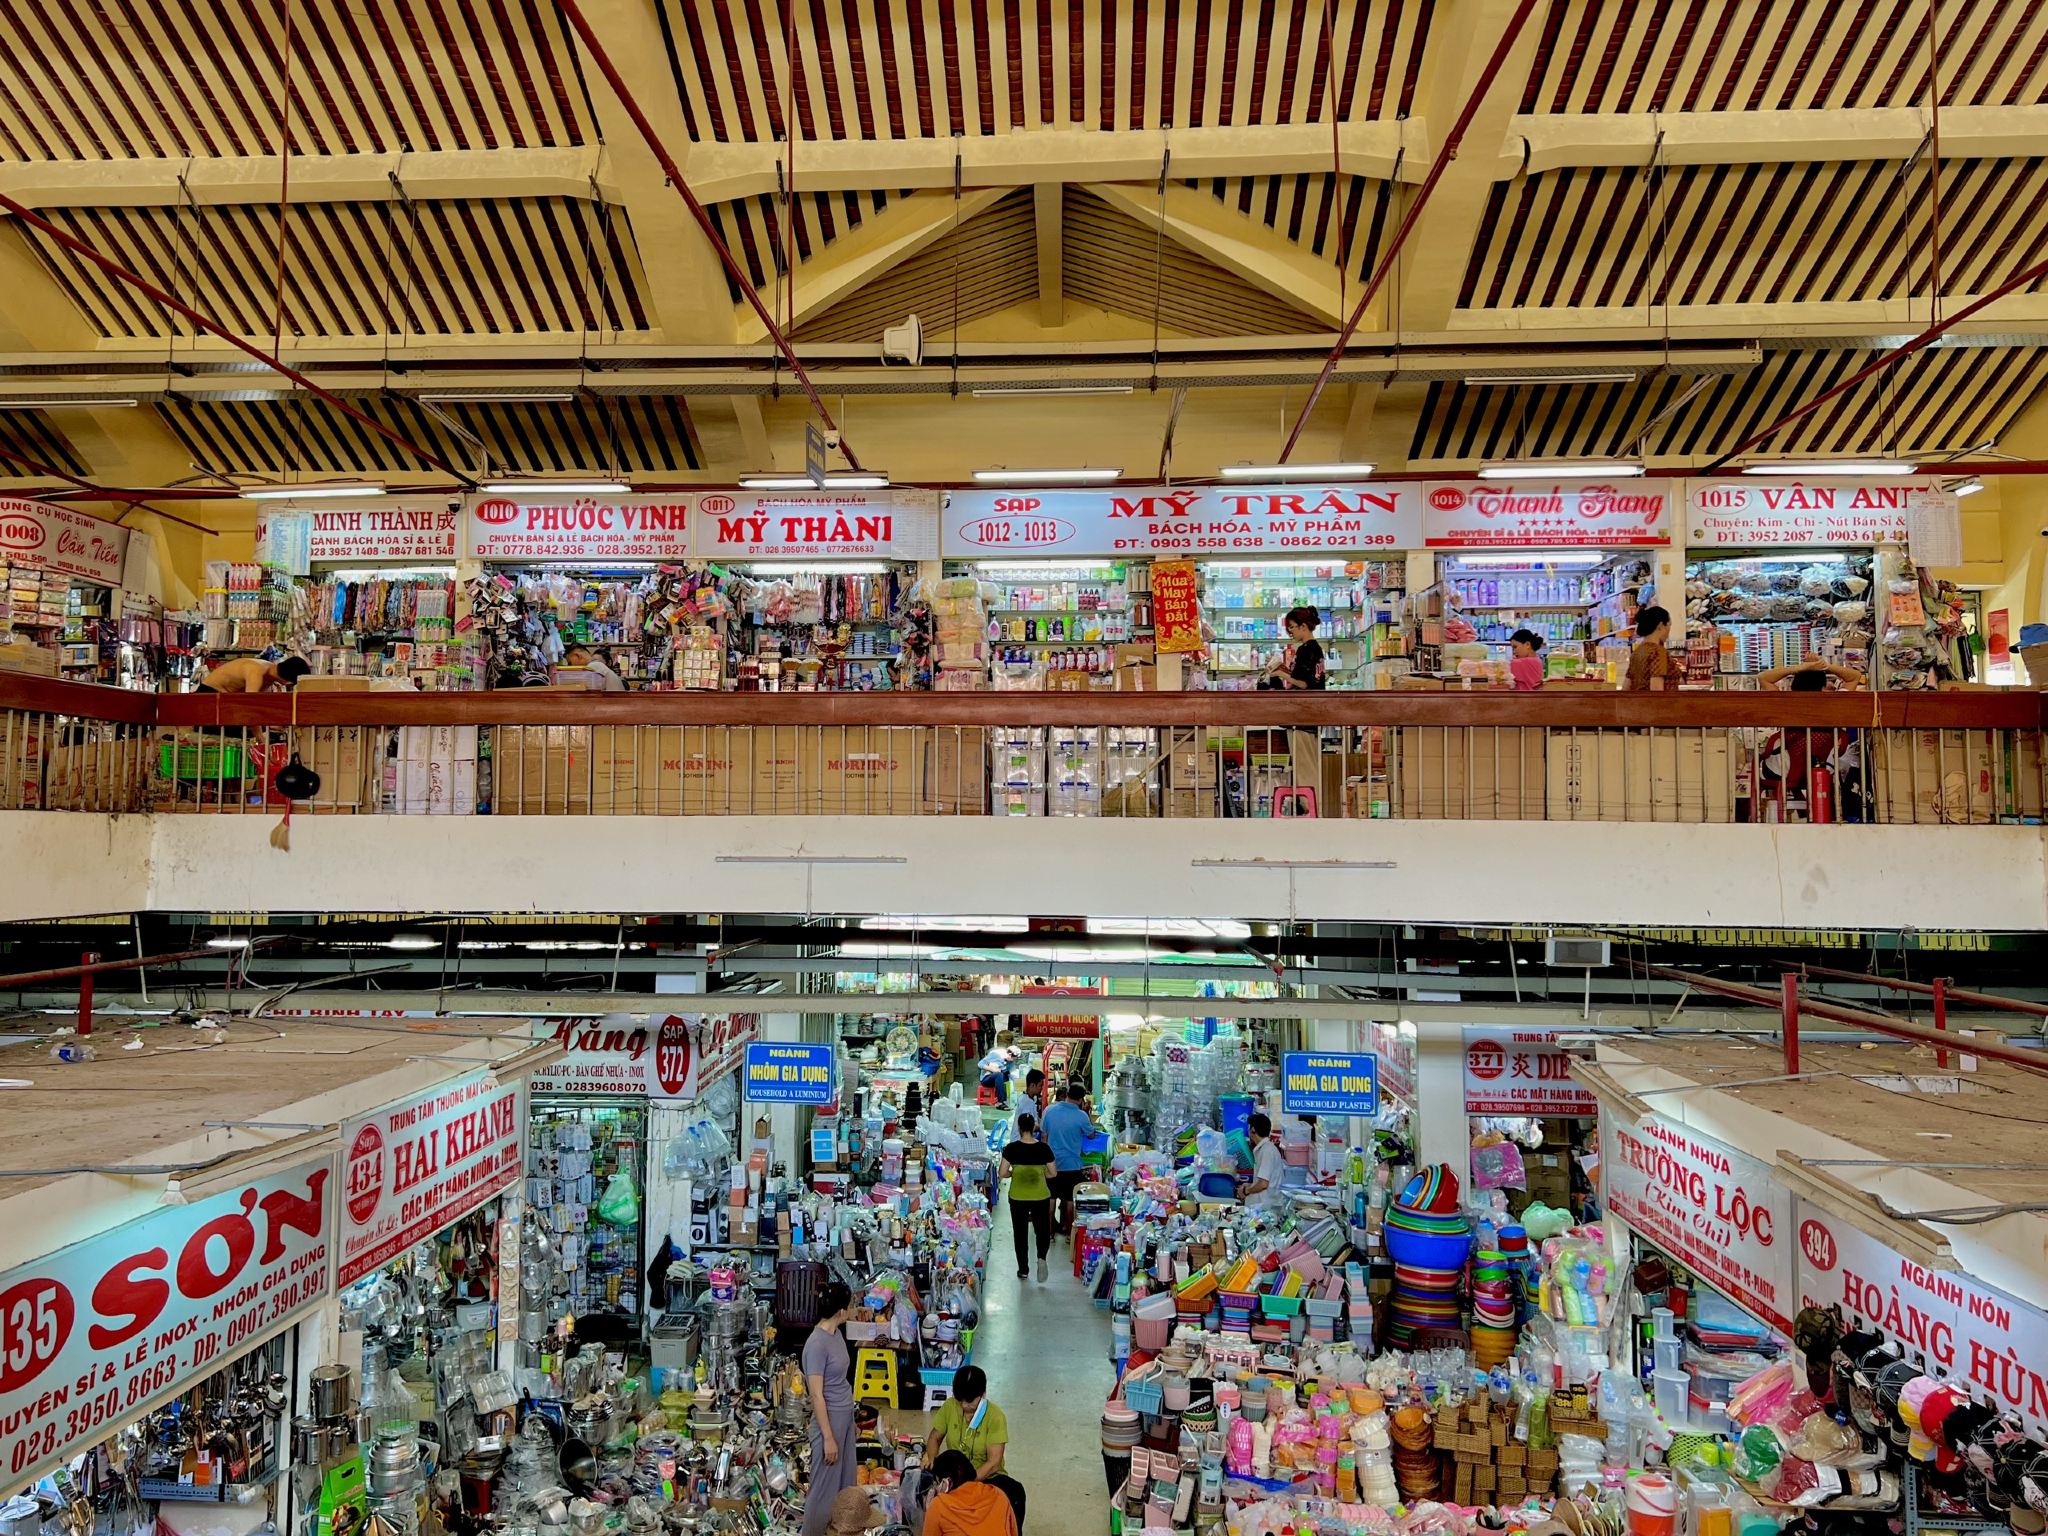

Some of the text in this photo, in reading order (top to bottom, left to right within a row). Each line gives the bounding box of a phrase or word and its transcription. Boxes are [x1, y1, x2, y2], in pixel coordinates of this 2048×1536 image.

[1107, 490, 1203, 518] MỸ
[1433, 494, 1461, 505] 1014
[1468, 484, 1664, 525] Thanh Giang
[1699, 490, 1746, 508] 1015
[1760, 482, 1837, 510] VÂN
[707, 499, 730, 511] 1011
[993, 498, 1041, 515] SẠP
[313, 512, 362, 531] MINH
[367, 506, 433, 531] THÀNH
[483, 498, 686, 531] 1010 PHƯỚC VINH
[1758, 517, 1782, 527] Kim
[717, 509, 770, 543] MỸ
[978, 521, 1056, 542] 1012 1013
[1148, 513, 1361, 535] BÁCH HÓA MỸ PHẨM
[344, 533, 373, 545] BÁCH
[1114, 535, 1395, 549] ĐT: 0903 558 638 0862 021 389
[1748, 530, 1779, 542] 3952
[1783, 530, 1814, 542] 2087
[1827, 530, 1858, 542] 0903
[328, 546, 454, 556] 3952 1408 0847 681 546
[503, 544, 584, 555] 0778.842.936
[597, 544, 687, 555] 028.3952.1827
[1161, 576, 1188, 587] Mua
[1163, 588, 1188, 600] May
[1164, 599, 1188, 610] Bán
[663, 1025, 684, 1042] SẠP
[1036, 1026, 1086, 1035] NO SMOKING
[1512, 1033, 1542, 1042] TRUNG
[769, 1048, 810, 1058] NGÀNH
[1469, 1053, 1503, 1067] 371
[661, 1045, 684, 1082] 372
[1050, 1063, 1064, 1071] 3M
[1308, 1058, 1351, 1068] NGÀNH
[749, 1061, 828, 1086] NHÔM GIA DỤNG
[565, 1082, 646, 1092] 02839608070
[750, 1089, 788, 1098] HOUSEHOLD
[1288, 1074, 1318, 1095] NHỰA
[1321, 1075, 1339, 1092] GIA
[1342, 1076, 1371, 1096] DỤNG
[1511, 1088, 1527, 1100] CÁC
[1289, 1100, 1371, 1110] HOUSEHOLD PLASTIS
[389, 1109, 416, 1134] TRUNG
[1690, 1142, 1732, 1176] NHỰA
[347, 1151, 382, 1197] 434
[1616, 1129, 1708, 1210] TRƯỜNG
[1714, 1183, 1775, 1247] LỘC
[401, 1193, 422, 1225] CÁC
[446, 1169, 469, 1200] HÀNG
[1806, 1224, 1830, 1267] 394
[88, 1167, 329, 1352] SƠN
[1901, 1250, 2010, 1333] NGÀNH NÓN
[1843, 1267, 1956, 1368] HOÀNG
[0, 1384, 69, 1439] UYÊN
[101, 1361, 117, 1381] &
[154, 1315, 199, 1353] INOX
[212, 1282, 259, 1322] NHÔM
[262, 1265, 287, 1292] GIA
[290, 1244, 326, 1278] DỤNG
[11, 1355, 177, 1474] 028.3950.8663
[227, 1266, 326, 1349] 0907.390.997
